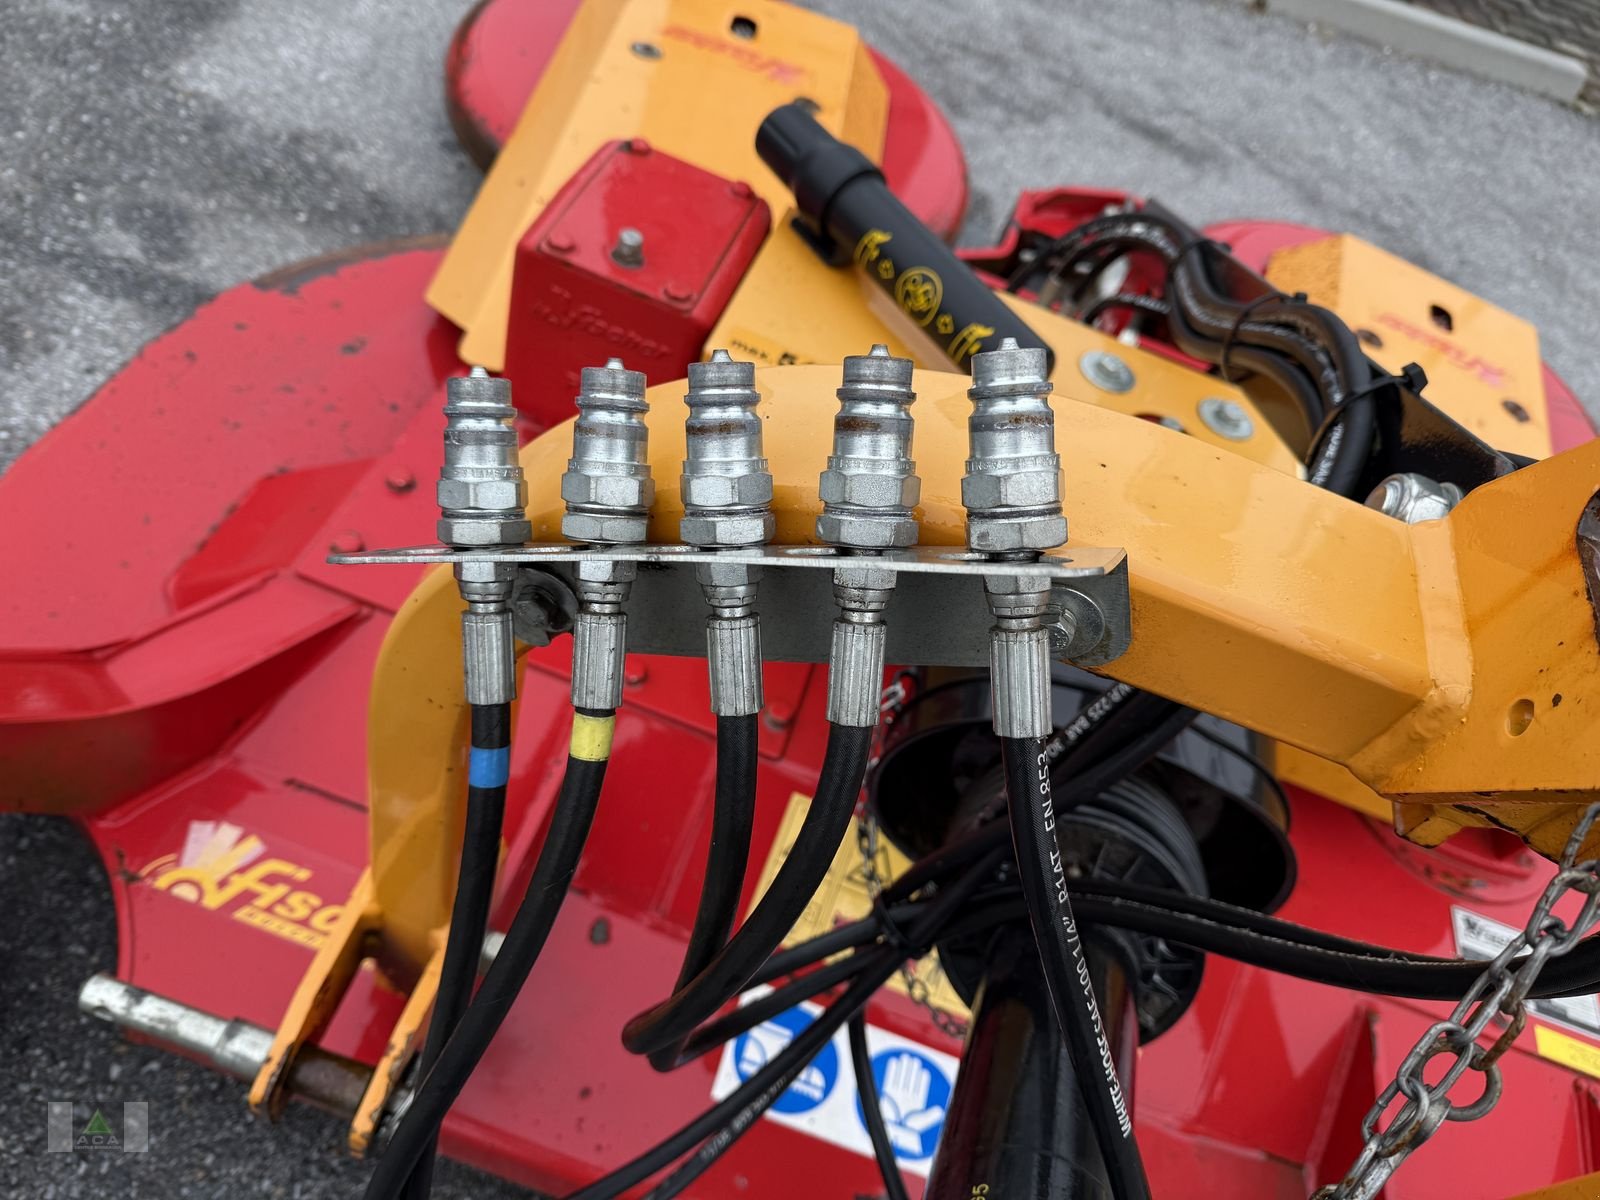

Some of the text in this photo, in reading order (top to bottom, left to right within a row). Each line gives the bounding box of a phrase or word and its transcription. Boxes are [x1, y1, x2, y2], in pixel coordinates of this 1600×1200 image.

[1063, 714, 1091, 741] BAR
[1037, 750, 1051, 795] 853
[1042, 798, 1056, 832] EN
